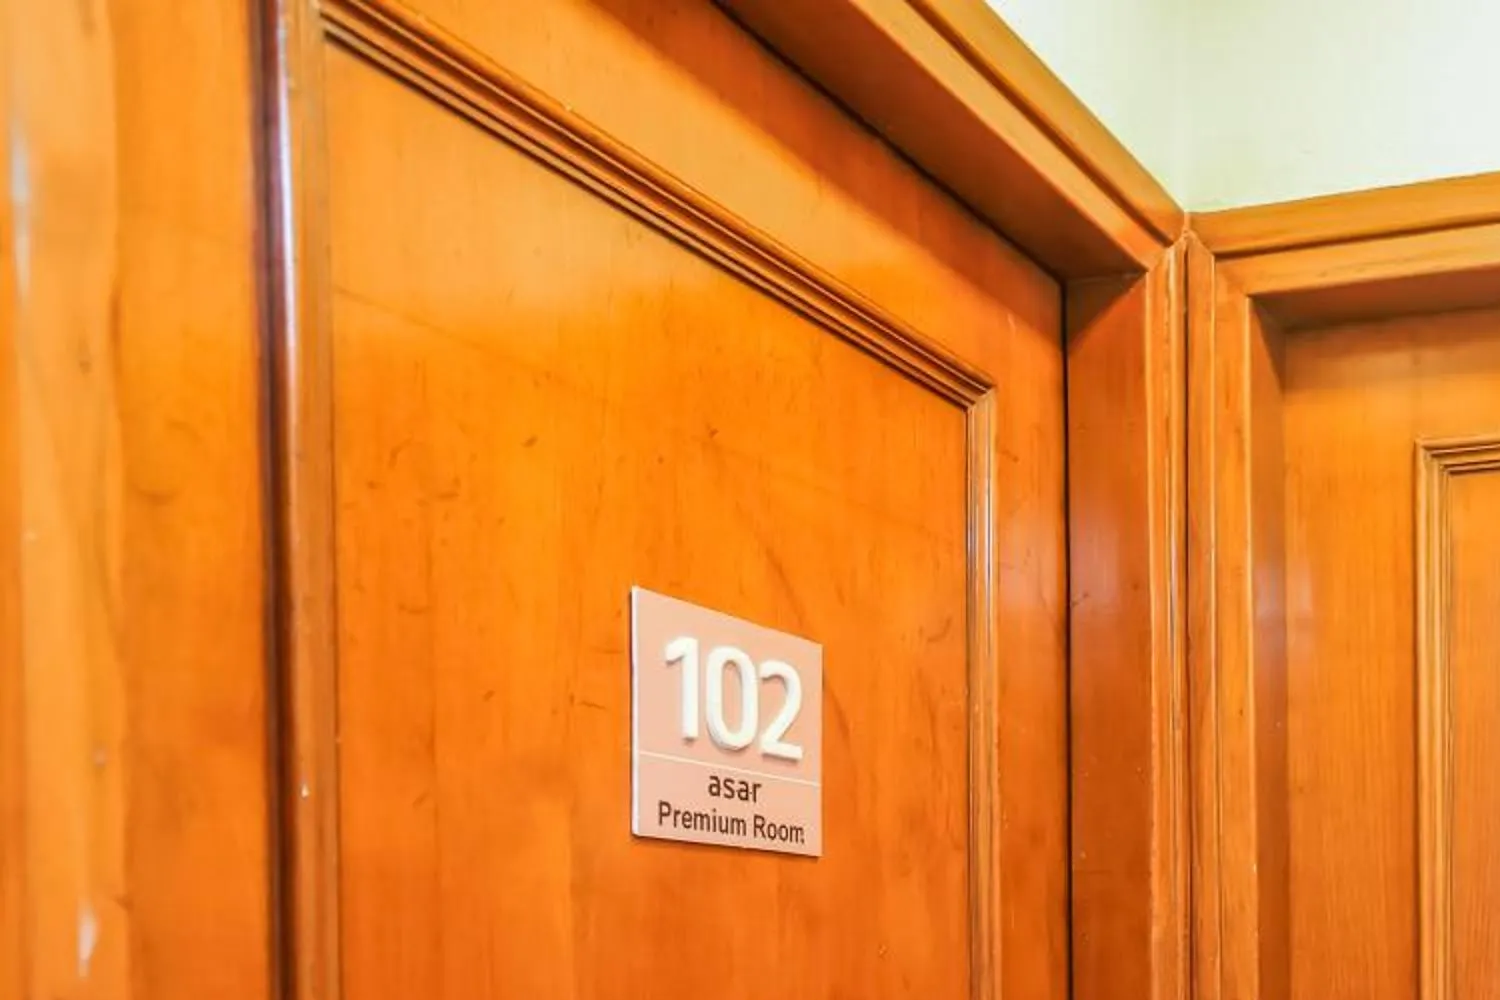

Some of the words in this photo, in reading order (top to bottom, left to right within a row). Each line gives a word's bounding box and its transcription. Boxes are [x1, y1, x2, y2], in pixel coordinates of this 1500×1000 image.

[665, 636, 803, 760] 102
[708, 775, 762, 803] asar
[658, 800, 747, 836] Premium
[753, 815, 805, 844] Room
